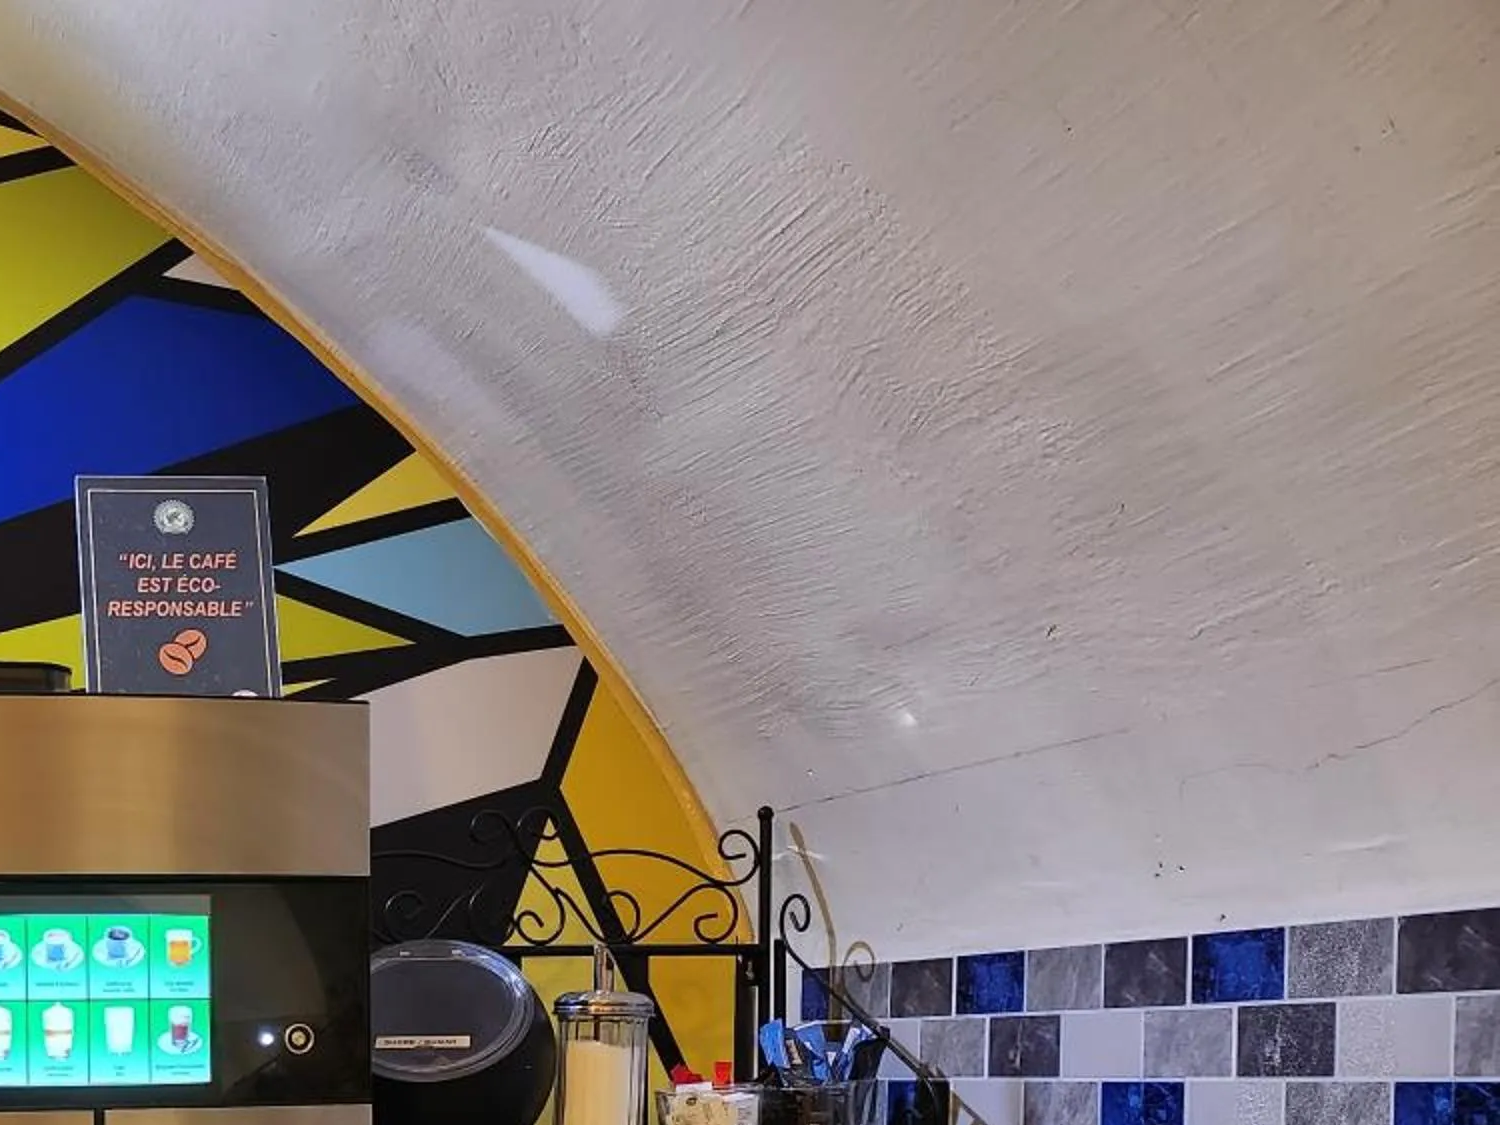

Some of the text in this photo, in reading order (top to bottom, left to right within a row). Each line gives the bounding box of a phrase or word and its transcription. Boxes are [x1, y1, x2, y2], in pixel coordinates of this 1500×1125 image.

[161, 554, 184, 570] LE
[189, 550, 237, 570] CAFÉ
[137, 574, 221, 593] EST ÉCO-
